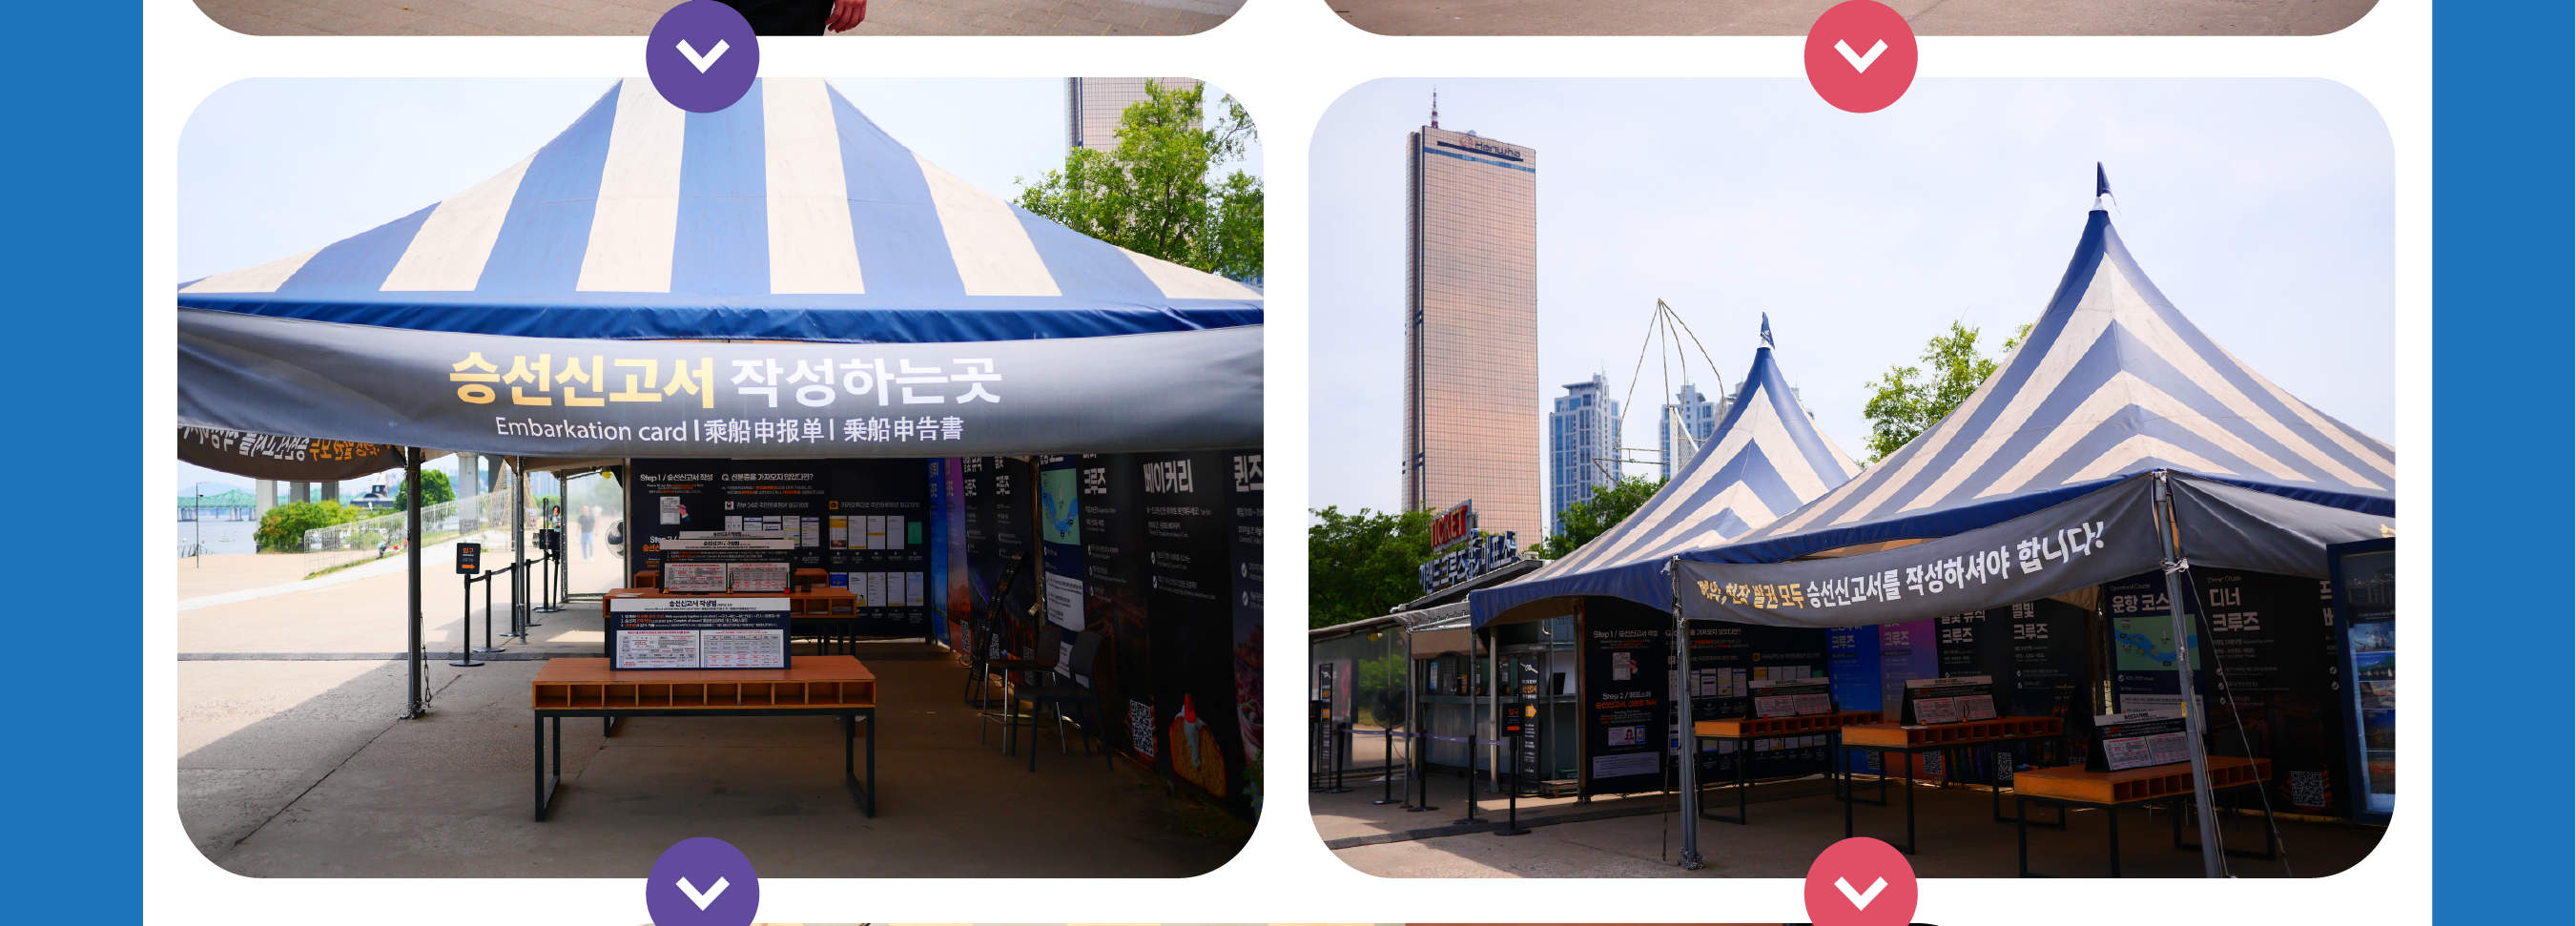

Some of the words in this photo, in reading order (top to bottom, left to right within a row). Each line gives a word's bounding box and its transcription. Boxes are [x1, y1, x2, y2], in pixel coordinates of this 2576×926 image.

[1474, 141, 1521, 158] Hanwha
[449, 352, 714, 409] 승선신고서
[730, 358, 1002, 408] 작성하는곳
[495, 417, 632, 441] Embarkation
[639, 420, 687, 442] card
[640, 473, 657, 483] Step
[1083, 467, 1107, 495] 크루즈
[1144, 459, 1194, 493] 베이커리
[1432, 504, 1469, 548] TICKET
[1725, 583, 1751, 607] 현장
[1751, 583, 1779, 609] 발권
[1778, 583, 1804, 609] 모두
[1806, 567, 1902, 609] 승선신고서를
[1905, 550, 2010, 597] 작성하셔야
[2017, 521, 2105, 574] 합니다!
[669, 600, 699, 608] 승선신고서
[699, 600, 717, 608] 작성법
[2112, 594, 2139, 614] 운항
[2141, 592, 2171, 611] 코스
[2209, 587, 2241, 607] 디너
[2212, 611, 2260, 632] 크루즈
[1831, 634, 1856, 649] 크루즈
[1885, 630, 1910, 647] 크루즈
[1942, 628, 1974, 644] 크루즈
[2013, 623, 2049, 641] 크루즈
